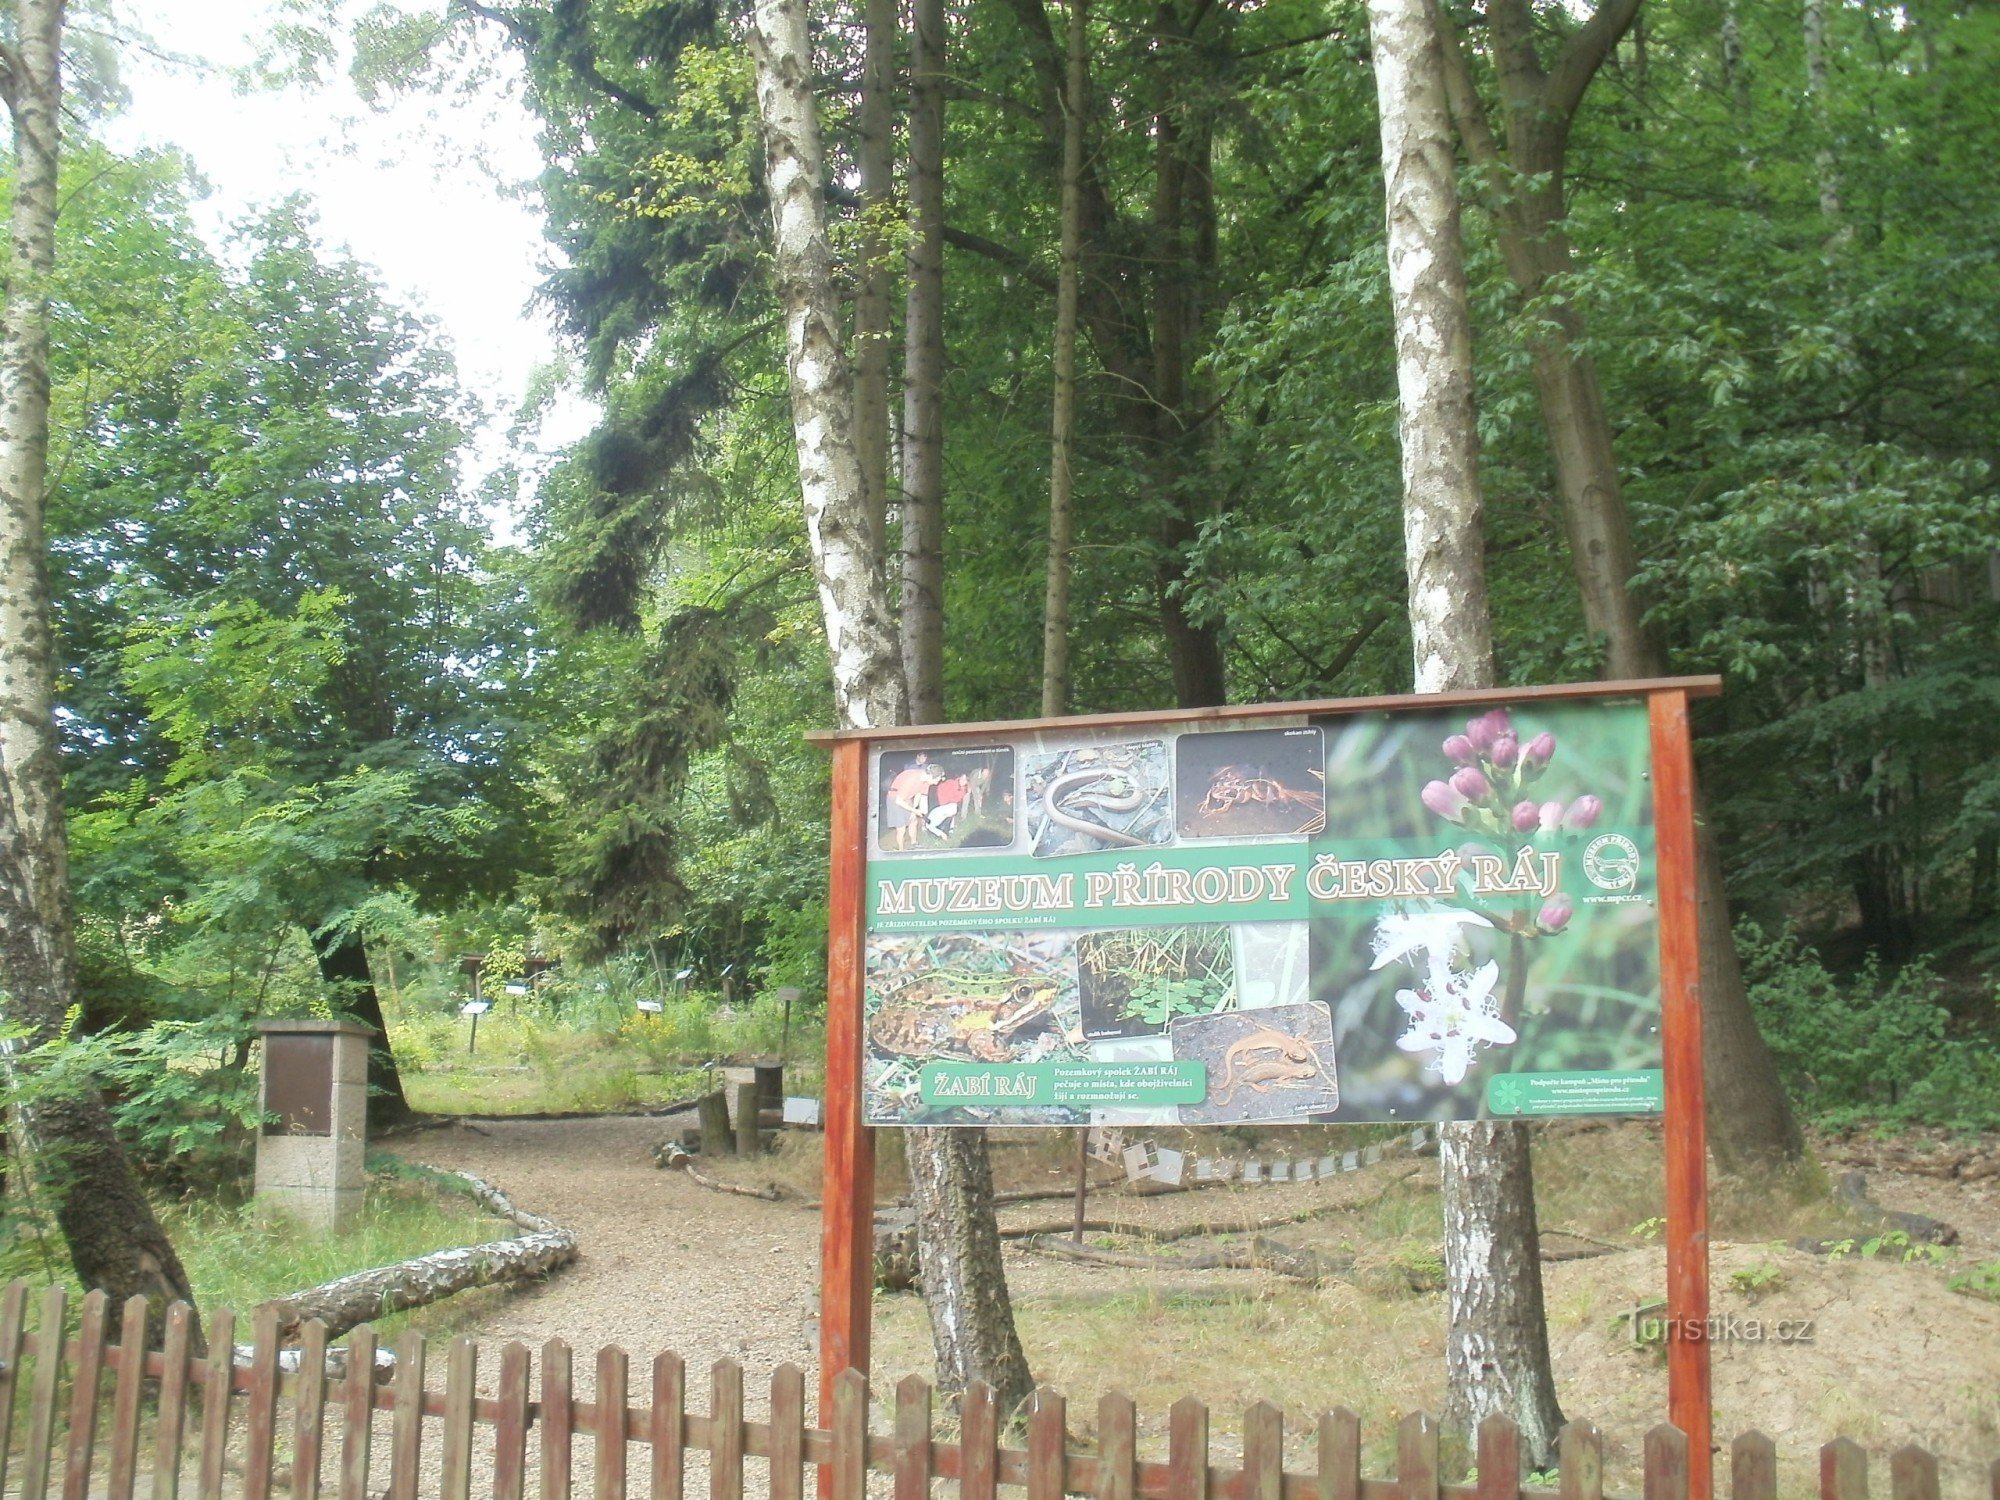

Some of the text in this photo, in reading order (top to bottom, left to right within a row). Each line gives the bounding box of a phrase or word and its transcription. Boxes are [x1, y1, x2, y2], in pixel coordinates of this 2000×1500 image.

[877, 873, 1074, 914] MUZEUM
[1084, 861, 1296, 908] PŘÍRODY
[1306, 849, 1461, 899] ČESKÝ
[1472, 845, 1560, 897] RÁJ
[1582, 894, 1643, 905] www.mpcr.cz
[885, 919, 938, 928] ZŘIZOVATELEM
[938, 917, 993, 926] POZEMKOVÉHO
[994, 916, 1022, 925] SPOLKU
[1024, 915, 1041, 924] ŽABÍ
[1043, 916, 1056, 924] RÁJ
[1054, 1065, 1178, 1078] Pozemkový spolek ŽABÍ RÁJ
[933, 1071, 1037, 1100] ŽABÍ RÁJ
[1054, 1080, 1082, 1091] pečuje
[1091, 1080, 1118, 1089] místa,
[1120, 1079, 1134, 1088] kde
[1137, 1078, 1193, 1090] obojživelníci
[1054, 1092, 1067, 1102] žijí
[1077, 1092, 1126, 1102] rozmnožují
